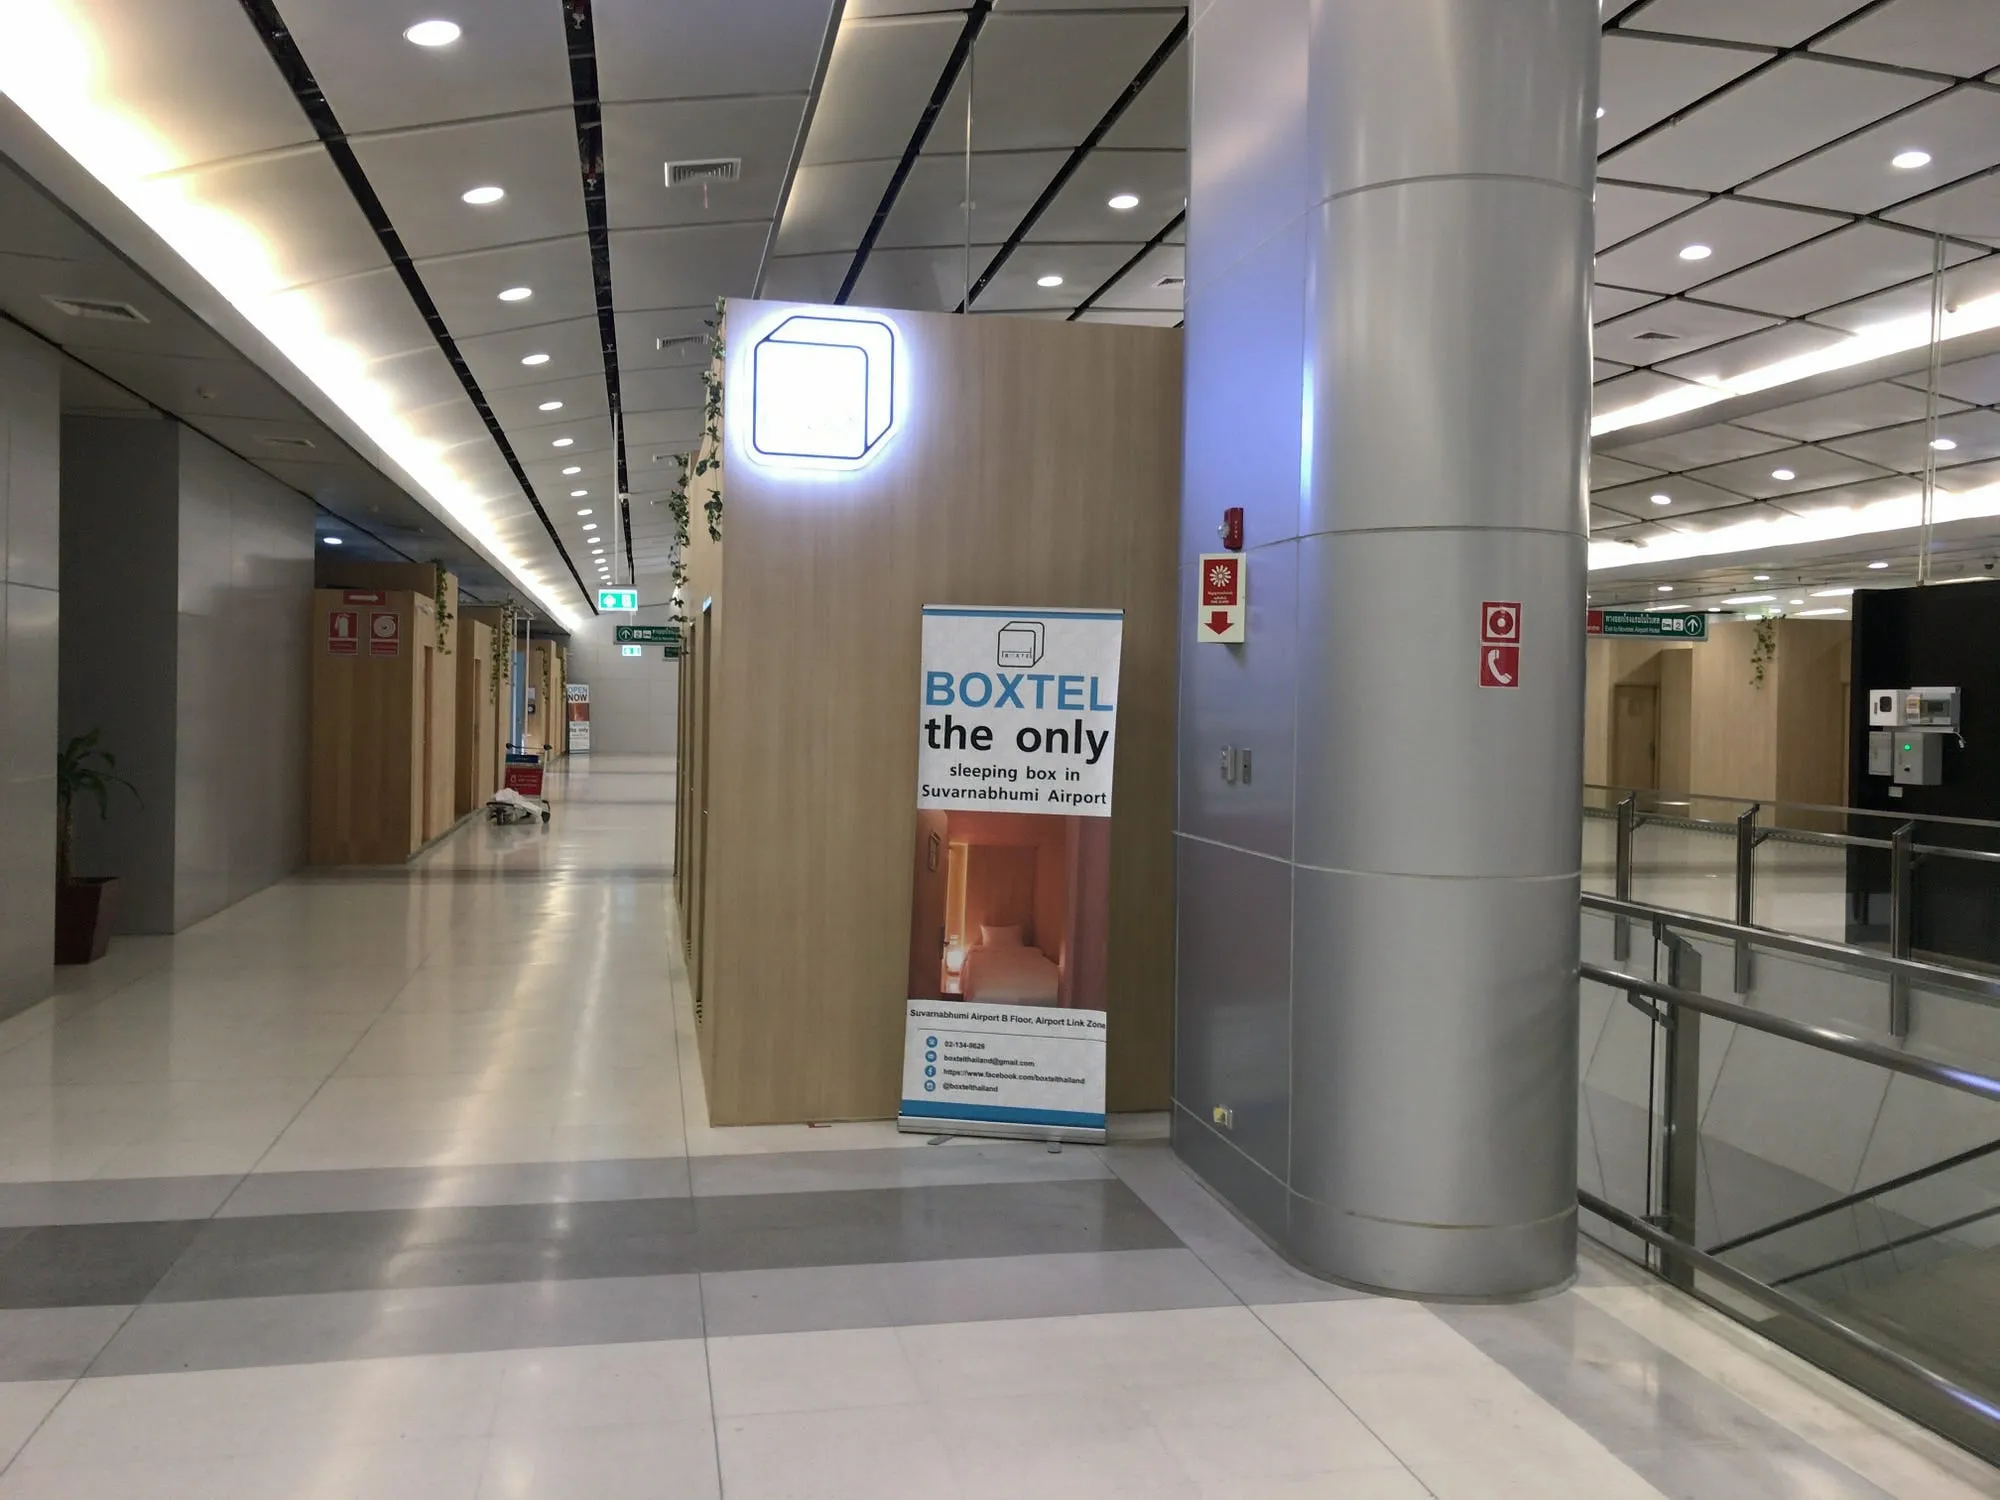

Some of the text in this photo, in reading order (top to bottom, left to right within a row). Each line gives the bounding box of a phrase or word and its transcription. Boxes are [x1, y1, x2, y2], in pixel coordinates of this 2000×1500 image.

[926, 671, 1113, 711] BOXTEL
[924, 715, 1109, 764] the only
[950, 763, 1080, 782] sleeping box in
[922, 784, 1106, 806] Suvarnabhumi Airport
[910, 1009, 969, 1020] Suvarnabhumi
[971, 1013, 999, 1022] Airport
[1002, 1014, 1008, 1022] B
[1036, 1017, 1064, 1026] Airport
[1067, 1019, 1085, 1027] Link
[1087, 1020, 1105, 1029] Zone
